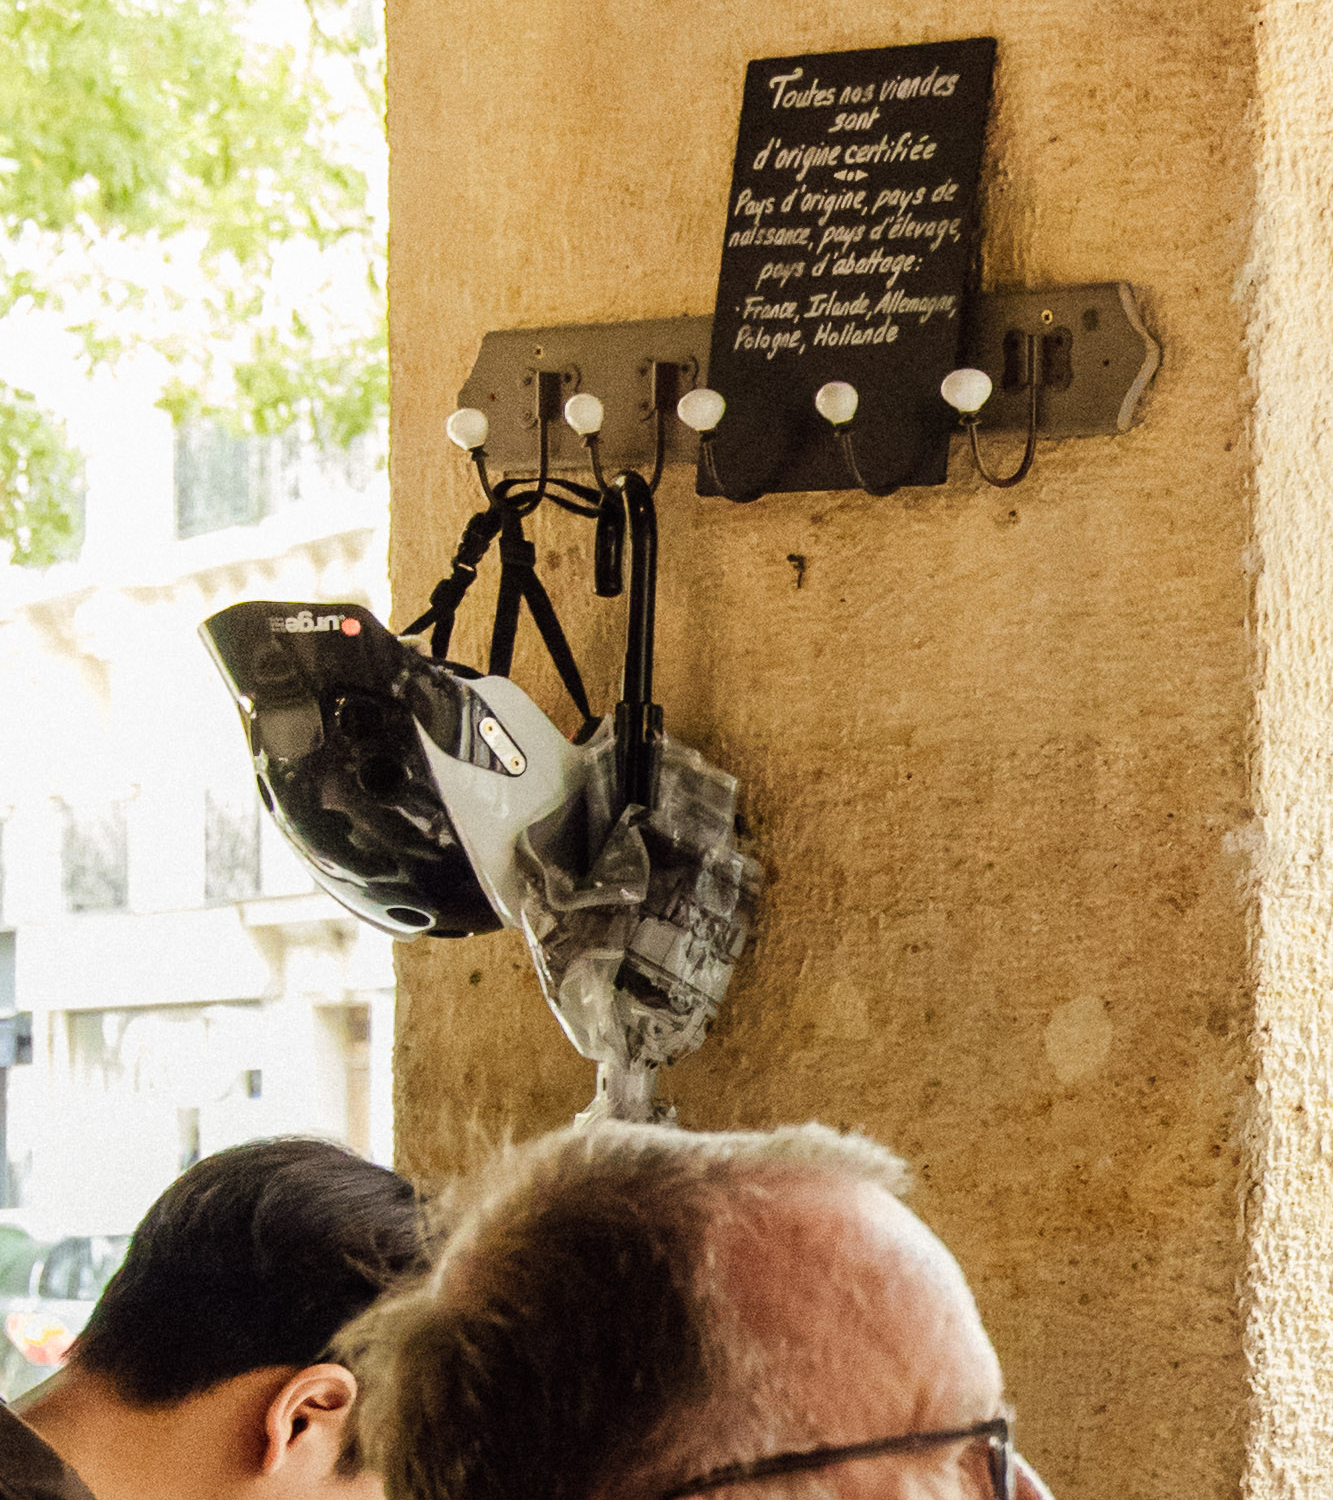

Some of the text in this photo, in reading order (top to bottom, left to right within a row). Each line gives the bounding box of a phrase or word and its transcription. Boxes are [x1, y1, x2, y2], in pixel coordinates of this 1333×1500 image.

[769, 66, 960, 109] Toutes nos viandes
[828, 106, 880, 133] sont
[752, 131, 938, 182] d'origine certifiée
[734, 179, 960, 227] Pays d'origine, pays de
[816, 224, 866, 255] pays
[869, 212, 962, 252] d'élevage,
[754, 261, 806, 291] pays
[743, 289, 957, 324] France, Irlande, Allemagne,
[734, 315, 900, 360] Pologne, Hollande
